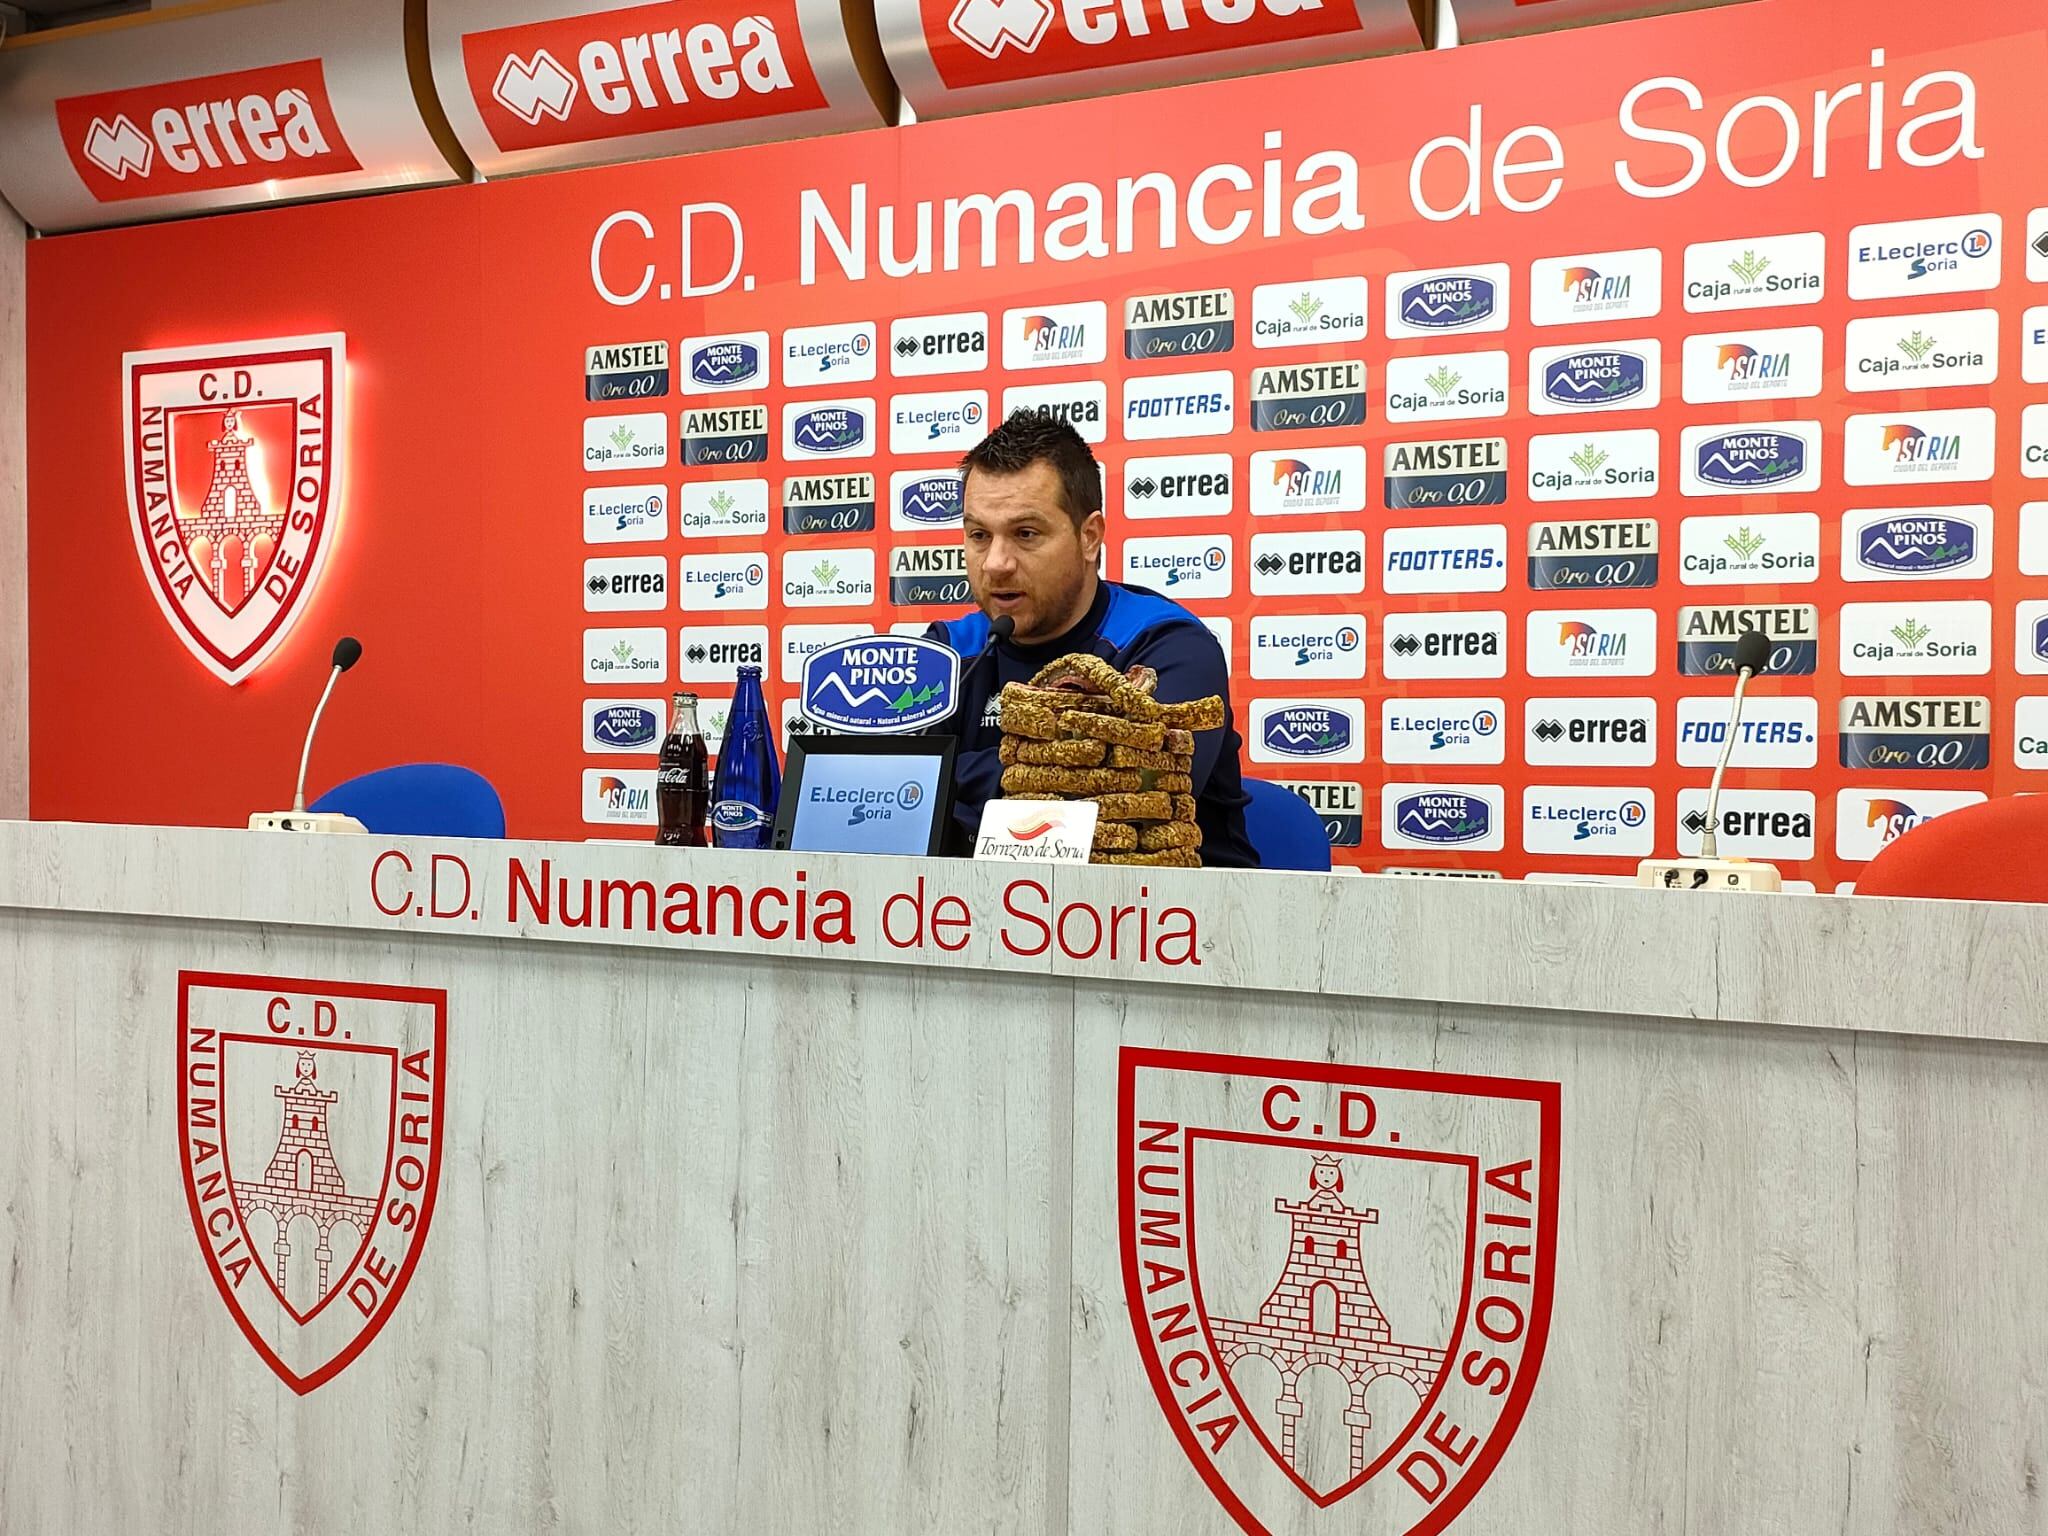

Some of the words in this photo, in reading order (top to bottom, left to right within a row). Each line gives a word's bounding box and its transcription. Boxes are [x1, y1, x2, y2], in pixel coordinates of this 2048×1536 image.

[590, 202, 757, 307] C.D.
[800, 130, 1365, 285] Numancia
[1408, 104, 1565, 222] de
[1614, 48, 1986, 199] Soria
[1859, 240, 1958, 262] E.Leclerc
[1907, 258, 1957, 280] Soria
[1423, 280, 1472, 293] MONTE
[1576, 275, 1631, 302] SORIA
[1688, 281, 1731, 300] Caja
[1766, 273, 1820, 291] Soria
[1428, 292, 1472, 304] PINOS
[1132, 293, 1228, 324] AMSTEL
[1256, 319, 1291, 337] Caja
[1320, 312, 1364, 331] Soria
[1035, 324, 1085, 351] SORIA
[1146, 337, 1177, 354] Oro
[591, 346, 664, 371] AMSTEL
[707, 344, 742, 357] MONTE
[789, 342, 850, 357] E.Leclerc
[711, 353, 742, 365] PINOS
[819, 355, 850, 372] Soria
[1568, 356, 1620, 369] MONTE
[1731, 353, 1790, 380] SORIA
[1859, 357, 1900, 375] Caja
[1932, 352, 1983, 369] Soria
[1258, 366, 1360, 395] AMSTEL
[1575, 368, 1621, 379] PINOS
[198, 370, 263, 401] C.D.
[602, 382, 624, 397] Oro
[1390, 395, 1427, 411] Caja
[1458, 388, 1505, 405] Soria
[686, 409, 763, 434] AMSTEL
[811, 411, 847, 424] MONTE
[815, 420, 847, 432] PINOS
[897, 410, 961, 424] E.Leclerc
[1273, 409, 1307, 425] Oro
[928, 423, 960, 439] Soria
[586, 445, 612, 461] Caja
[632, 442, 664, 457] Soria
[1723, 436, 1778, 449] MONTE
[1897, 435, 1961, 462] SORIA
[699, 446, 723, 461] Oro
[1392, 443, 1499, 471] AMSTEL
[1730, 448, 1779, 460] PINOS
[919, 481, 957, 492] MONTE
[1287, 470, 1342, 496] SORIA
[1532, 471, 1573, 490] Caja
[1604, 468, 1655, 485] Soria
[264, 549, 301, 604] DE
[291, 393, 321, 534] SORIA
[789, 477, 870, 502] AMSTEL
[924, 490, 957, 502] PINOS
[1408, 486, 1445, 502] Oro
[141, 406, 196, 600] NUMANCIA
[589, 503, 644, 516] E.Leclerc
[616, 515, 644, 530] Soria
[684, 512, 710, 528] Caja
[732, 510, 765, 524] Soria
[801, 514, 828, 531] Oro
[1887, 521, 1947, 534] MONTE
[1536, 523, 1651, 551] AMSTEL
[1894, 533, 1947, 546] PINOS
[896, 549, 966, 571] AMSTE
[1130, 554, 1202, 569] E.Leclerc
[1684, 555, 1727, 572] Caja
[1762, 552, 1815, 569] Soria
[686, 571, 744, 583] E.Leclerc
[1166, 569, 1202, 586] Soria
[1554, 568, 1591, 584] Oro
[715, 582, 743, 599] Soria
[786, 581, 813, 597] Caja
[837, 579, 871, 594] Soria
[909, 586, 937, 600] Oro
[1687, 609, 1809, 635] AMSTEL
[1258, 635, 1334, 649] E.Leclerc
[1572, 632, 1626, 656] SORIA
[1853, 642, 1893, 660] Caja
[1926, 642, 1977, 657] Soria
[591, 657, 614, 671] Caja
[631, 657, 659, 669] Soria
[842, 647, 919, 666] MONTE
[1295, 648, 1333, 666] Soria
[851, 667, 918, 685] PINOS
[608, 710, 641, 719] MONTE
[612, 718, 641, 727] PINOS
[1284, 711, 1329, 722] MONTE
[1848, 701, 1981, 728] AMSTEL
[1290, 722, 1330, 733] PINOS
[1390, 718, 1470, 731] E.Leclerc
[1682, 721, 1813, 744] FOOTERS.
[1430, 732, 1470, 749] Soria
[1869, 744, 1910, 765] Oro
[610, 788, 648, 808] SORIA
[811, 786, 895, 805] E.Leclerc
[1288, 785, 1356, 810] STEL
[1418, 796, 1467, 808] MONTE
[848, 804, 891, 826] Soria
[1424, 808, 1468, 819] PINOS
[1532, 806, 1617, 821] E.Leclerc
[1574, 821, 1616, 840] Soria
[980, 837, 1033, 860] Torrezno
[1035, 837, 1050, 857] de
[369, 851, 481, 922] C.D.
[508, 857, 856, 945] Numancia
[883, 875, 973, 952] de
[1000, 878, 1202, 967] Soria
[267, 997, 351, 1039] C.D.
[1262, 1085, 1400, 1142] C.D.
[189, 1028, 253, 1289] NUMANCIA
[347, 1246, 397, 1319] DE
[386, 1049, 430, 1232] SORIA
[1138, 1120, 1240, 1455] NUMANCIA
[1396, 1411, 1479, 1504] DE
[1461, 1160, 1532, 1396] SORIA
